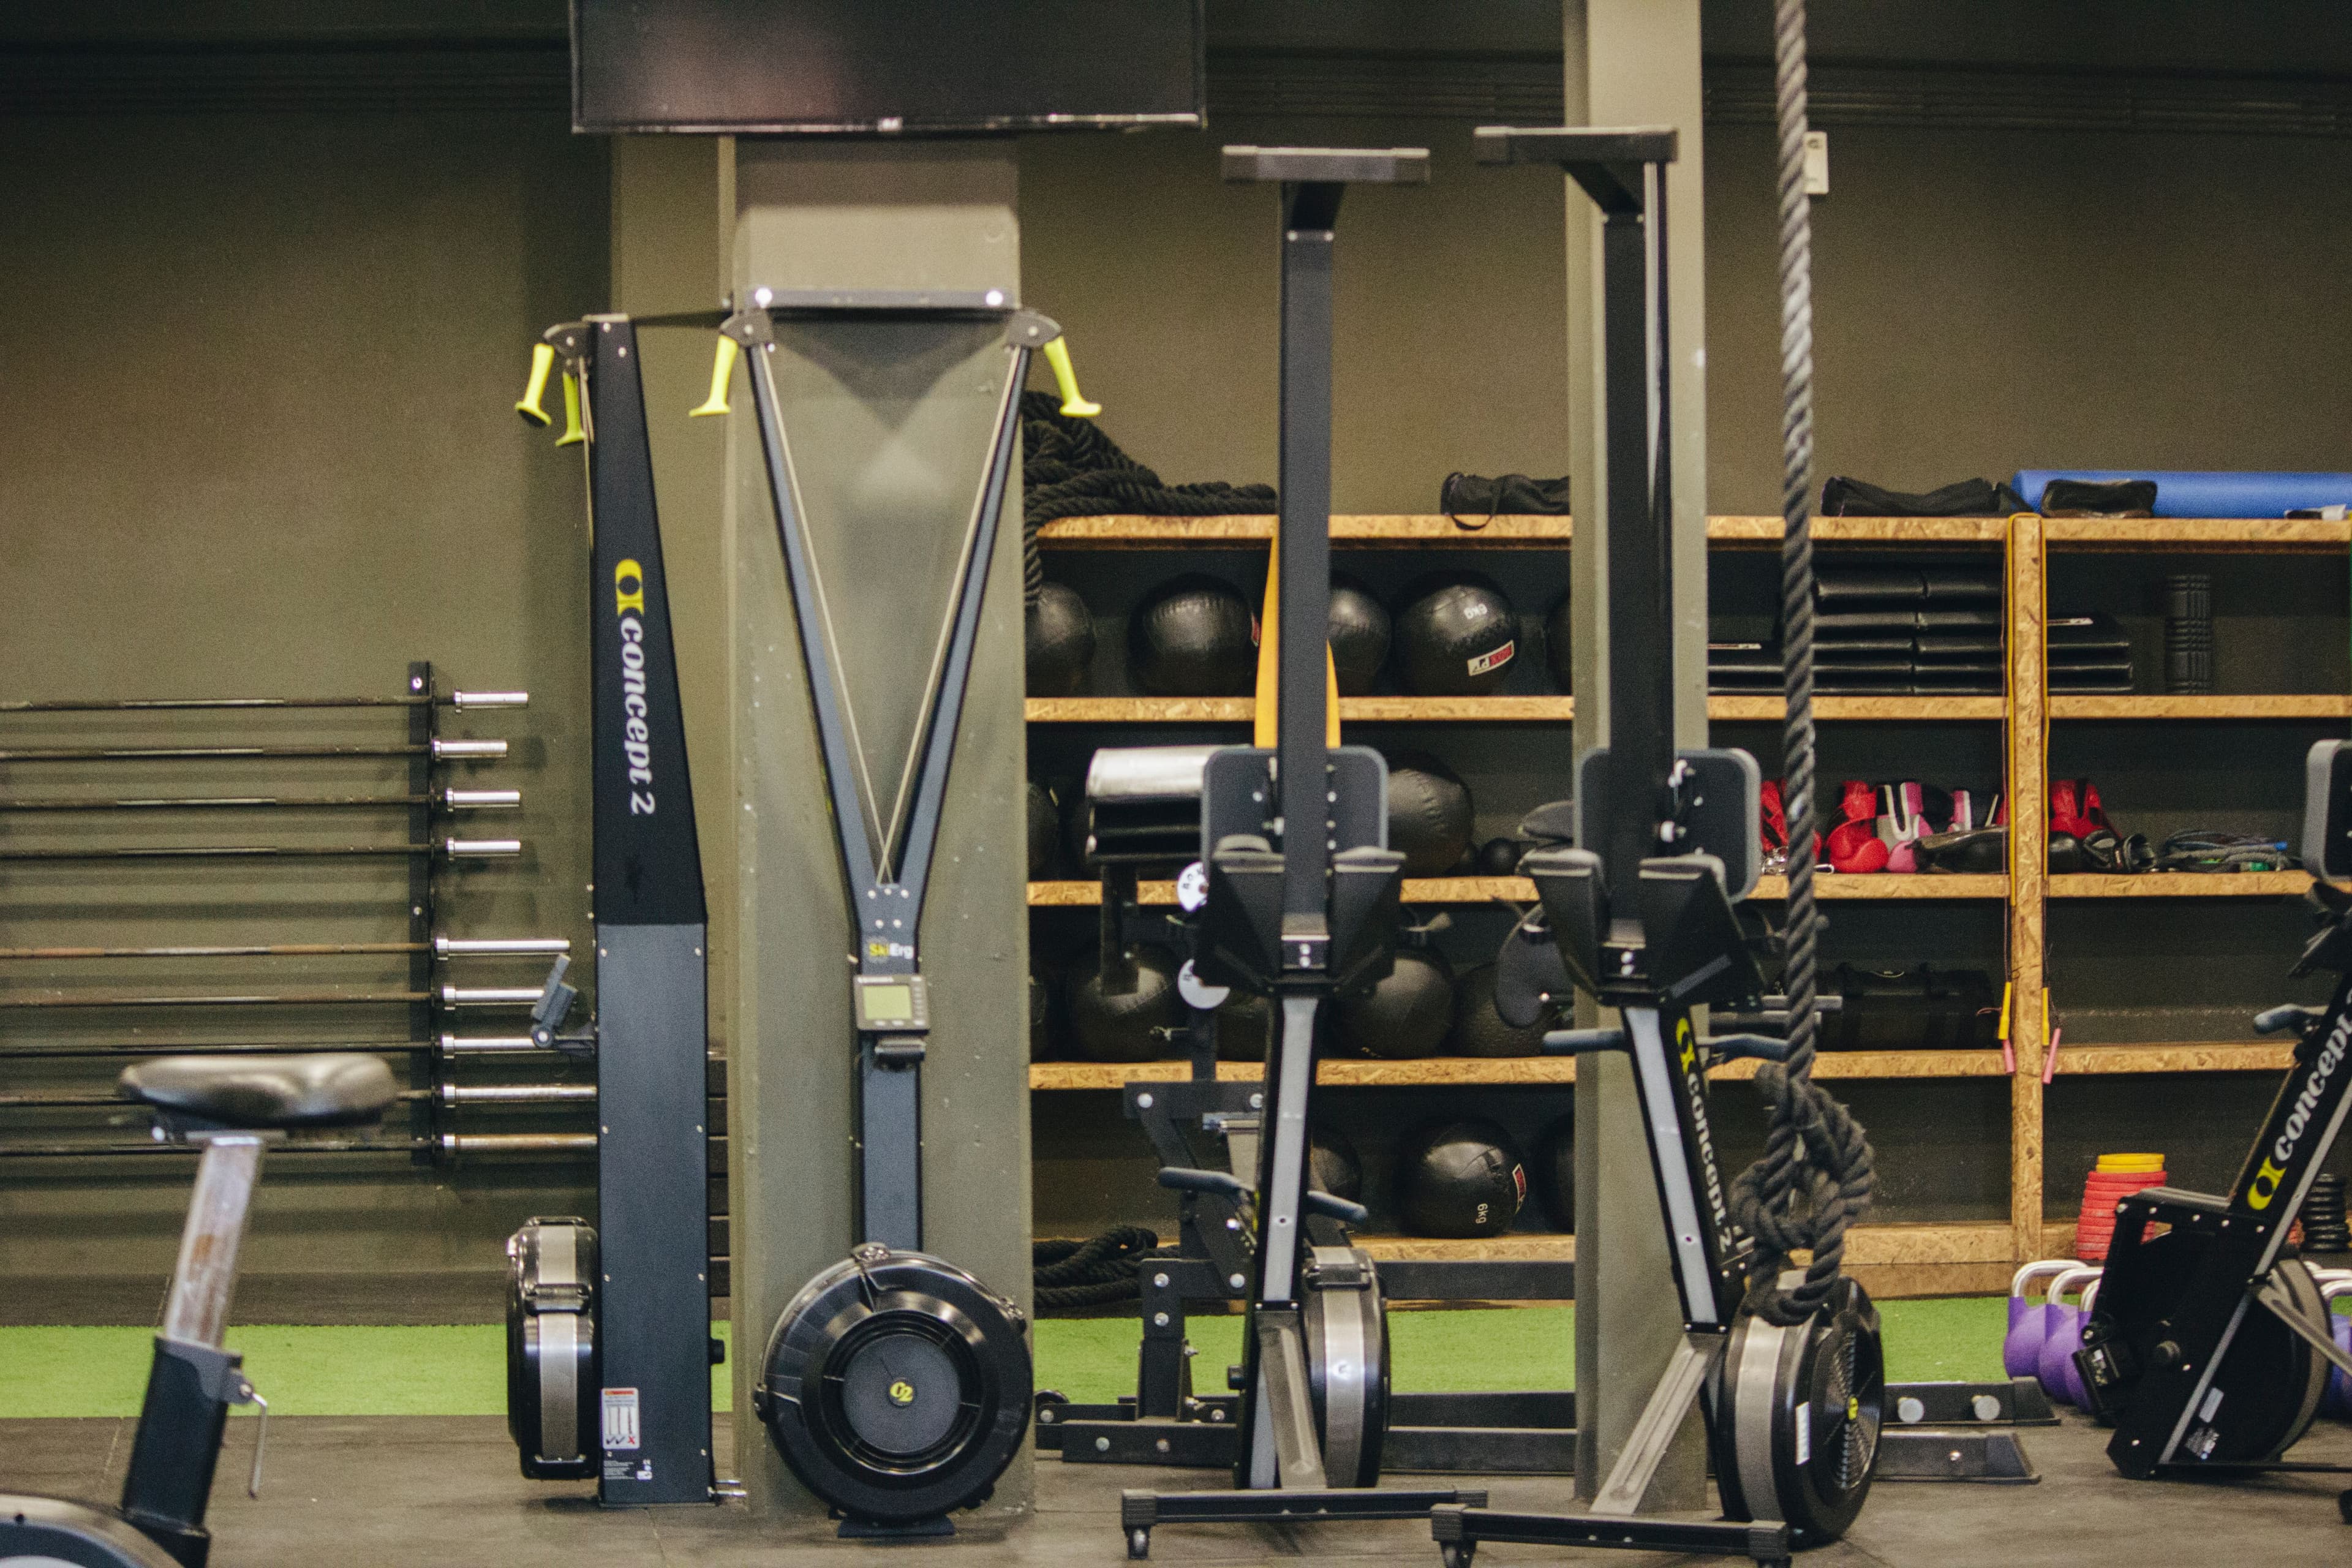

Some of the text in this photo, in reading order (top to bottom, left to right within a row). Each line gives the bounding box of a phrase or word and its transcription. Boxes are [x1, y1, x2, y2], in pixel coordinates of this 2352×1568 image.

[620, 617, 655, 815] concept 2
[1476, 1203, 1488, 1224] 6kg
[1687, 1073, 1732, 1254] concept 2
